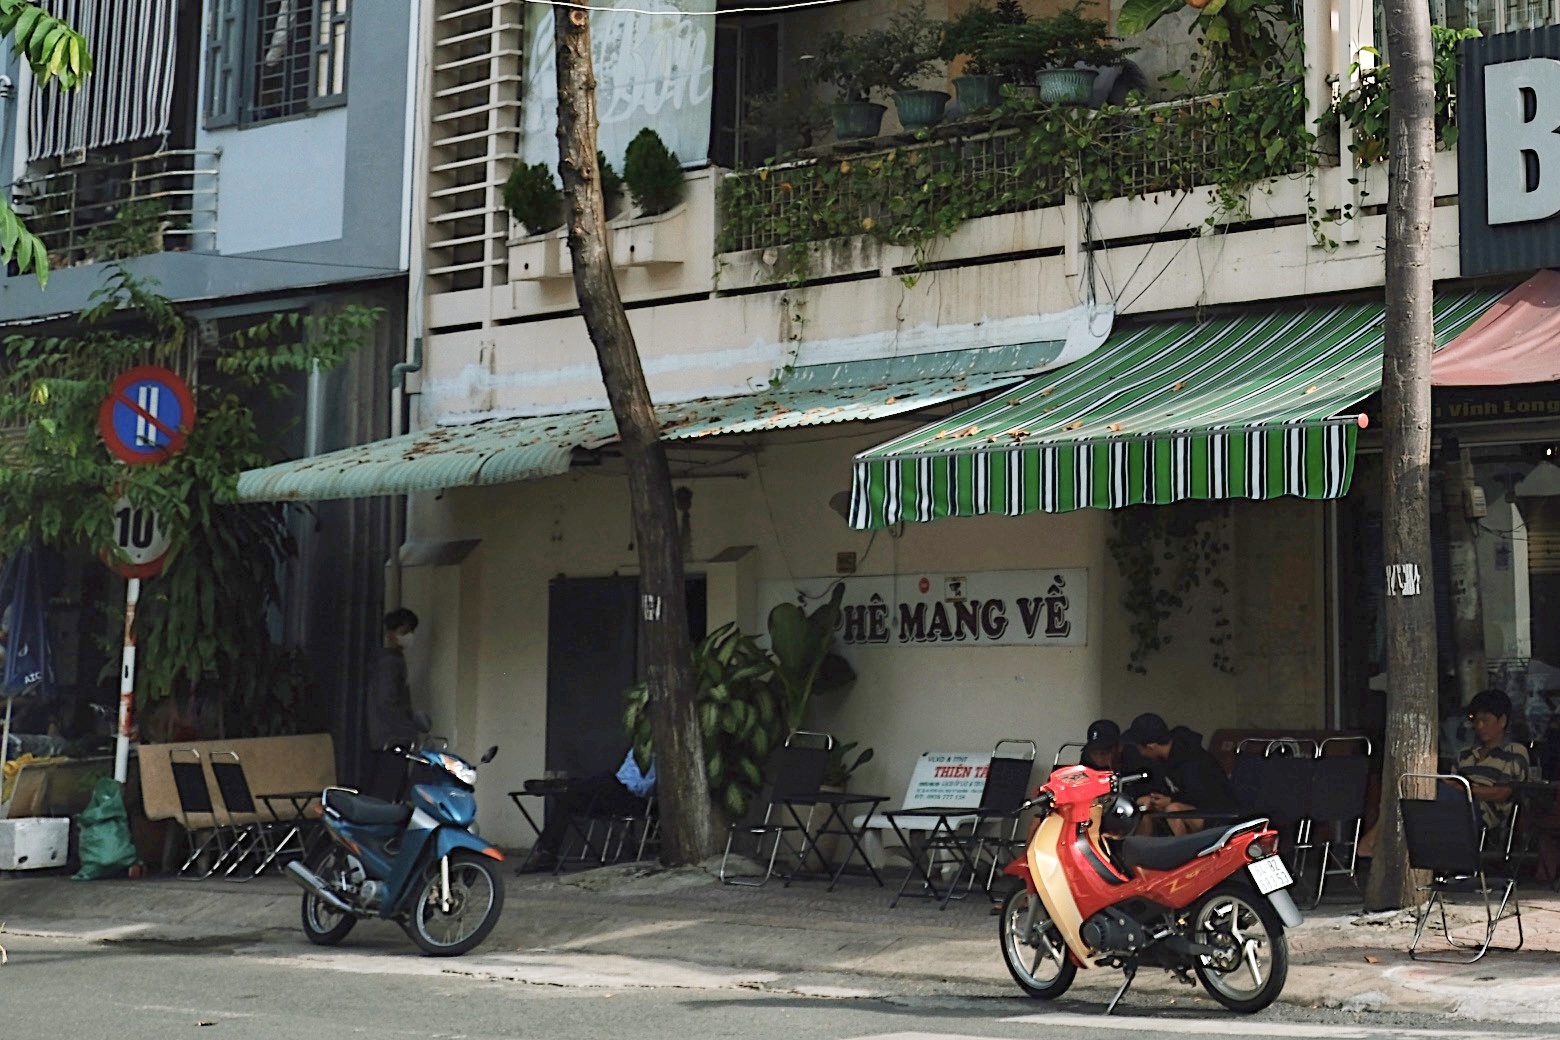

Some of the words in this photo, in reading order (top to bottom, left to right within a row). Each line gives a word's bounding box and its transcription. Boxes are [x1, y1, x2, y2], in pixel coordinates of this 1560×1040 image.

[1503, 399, 1560, 414] Long
[116, 507, 153, 548] 10
[834, 592, 888, 644] HÊ
[898, 596, 1008, 643] MANG
[1015, 574, 1071, 639] VỀ
